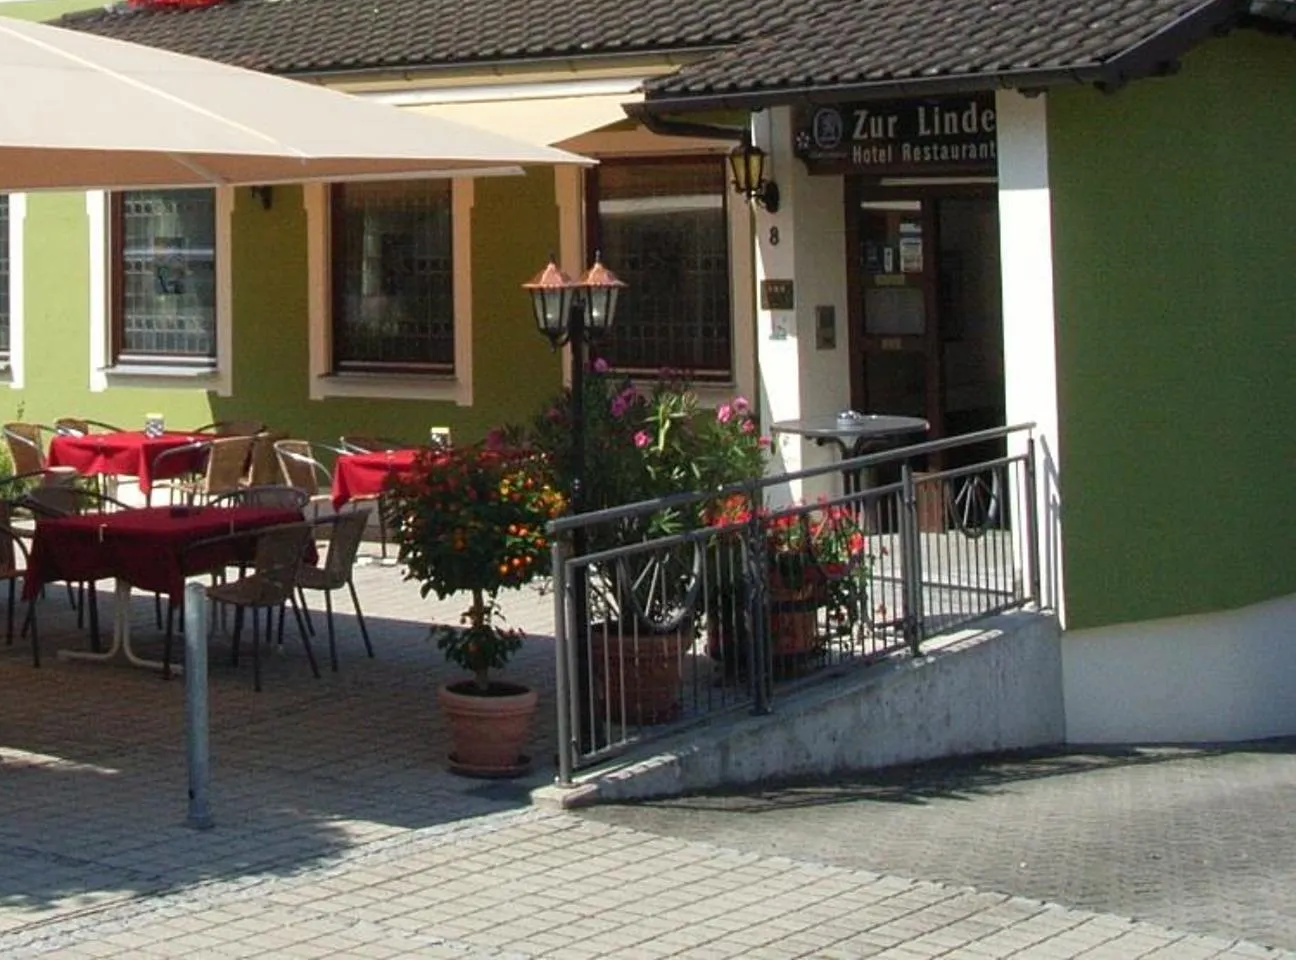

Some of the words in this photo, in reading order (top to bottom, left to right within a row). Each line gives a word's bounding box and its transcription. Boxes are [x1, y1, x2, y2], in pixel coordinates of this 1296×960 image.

[853, 109, 898, 140] Zur
[917, 102, 996, 137] Linde
[853, 145, 892, 165] Hotel
[903, 140, 996, 162] Restaurant
[769, 226, 779, 246] 8
